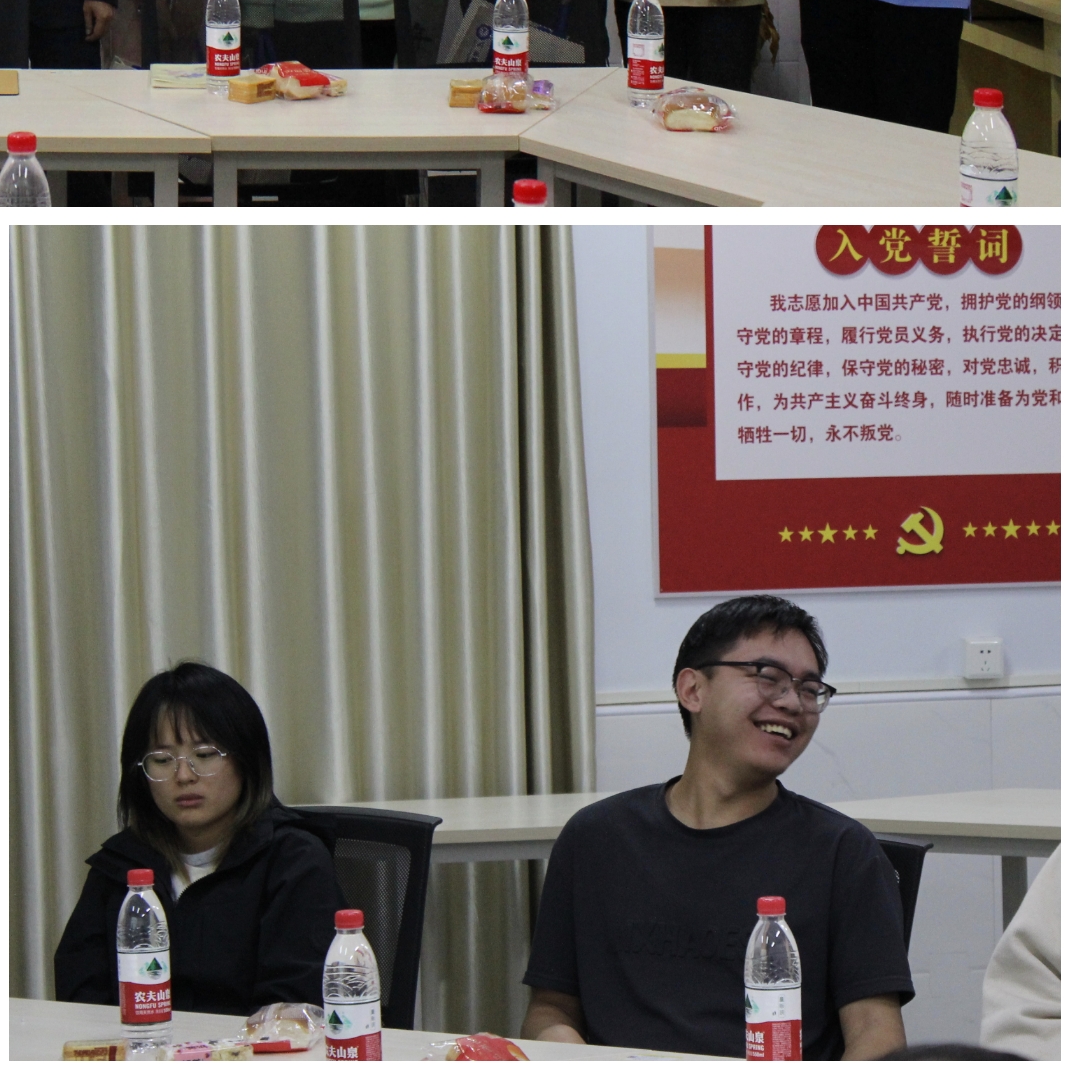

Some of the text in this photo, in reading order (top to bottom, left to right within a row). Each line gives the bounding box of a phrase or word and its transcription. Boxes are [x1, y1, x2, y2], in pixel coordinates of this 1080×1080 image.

[829, 227, 1009, 264] 入党誓词
[770, 292, 1061, 311] 我志愿加入中国共产党，拥护党的纲领
[737, 324, 1061, 345] 守党的章程，履行党员义务，执行党的决定
[737, 424, 902, 444] 牺牲一切，永不叛党。
